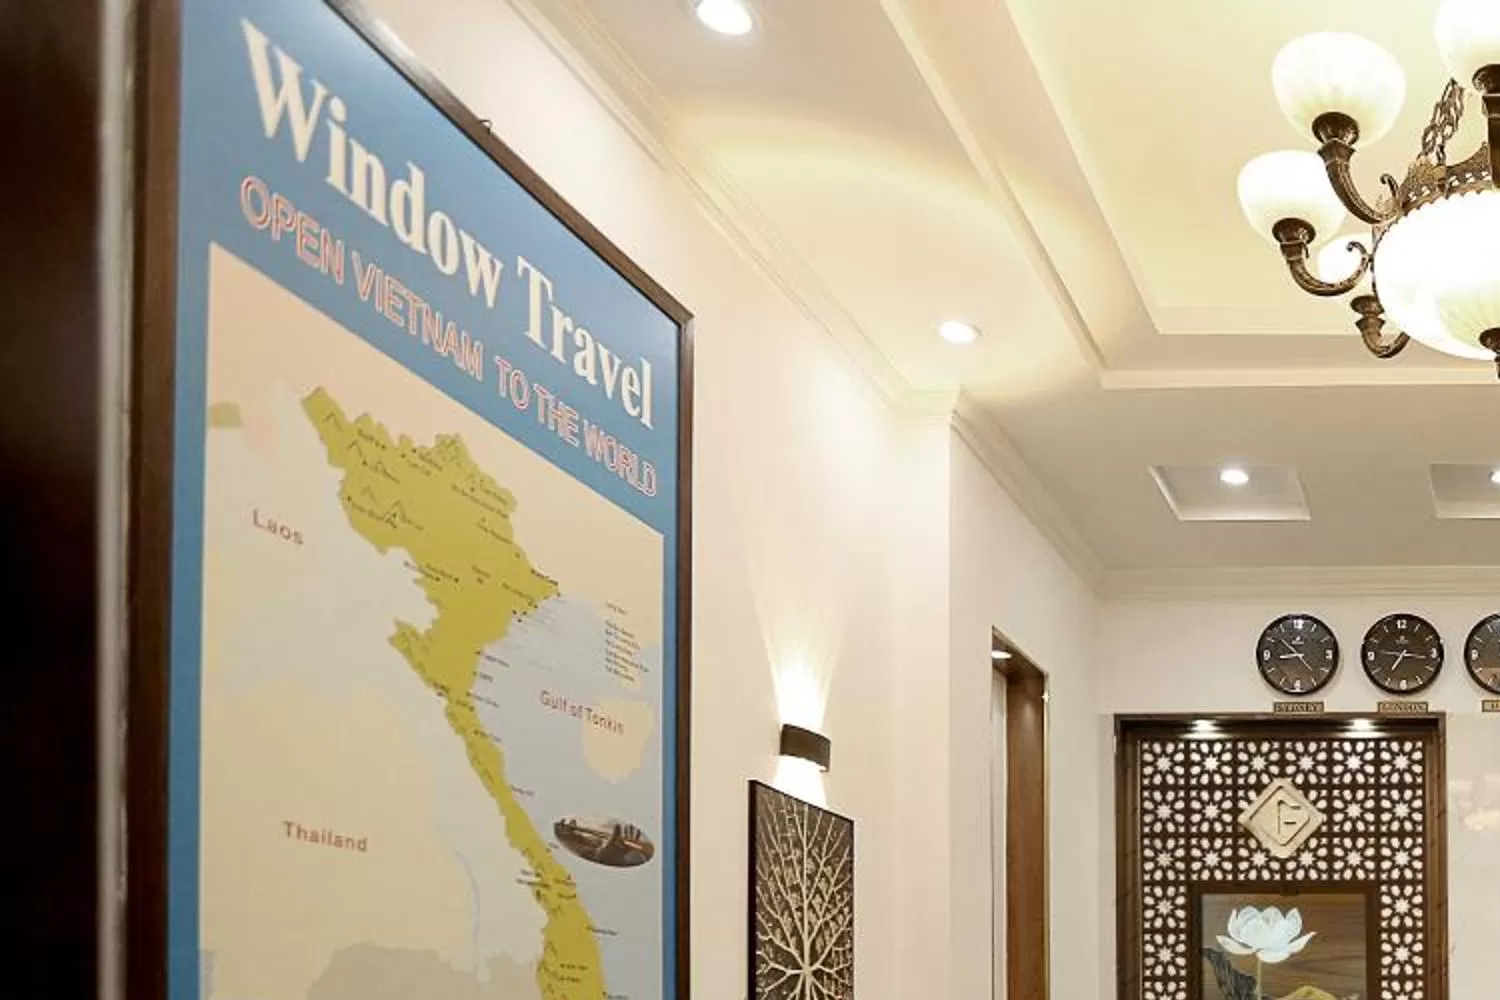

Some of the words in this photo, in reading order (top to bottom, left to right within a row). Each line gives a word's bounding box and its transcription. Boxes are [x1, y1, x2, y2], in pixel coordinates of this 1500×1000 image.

[241, 17, 503, 309] Window
[517, 255, 655, 431] Travel
[239, 175, 344, 286] OPEN
[351, 248, 483, 382] VIETNAM
[494, 355, 529, 409] TO
[534, 383, 580, 447] THE
[582, 415, 657, 497] WORLD
[253, 508, 303, 545] Laos
[540, 689, 567, 713] Gulf
[283, 820, 368, 852] Thailand
